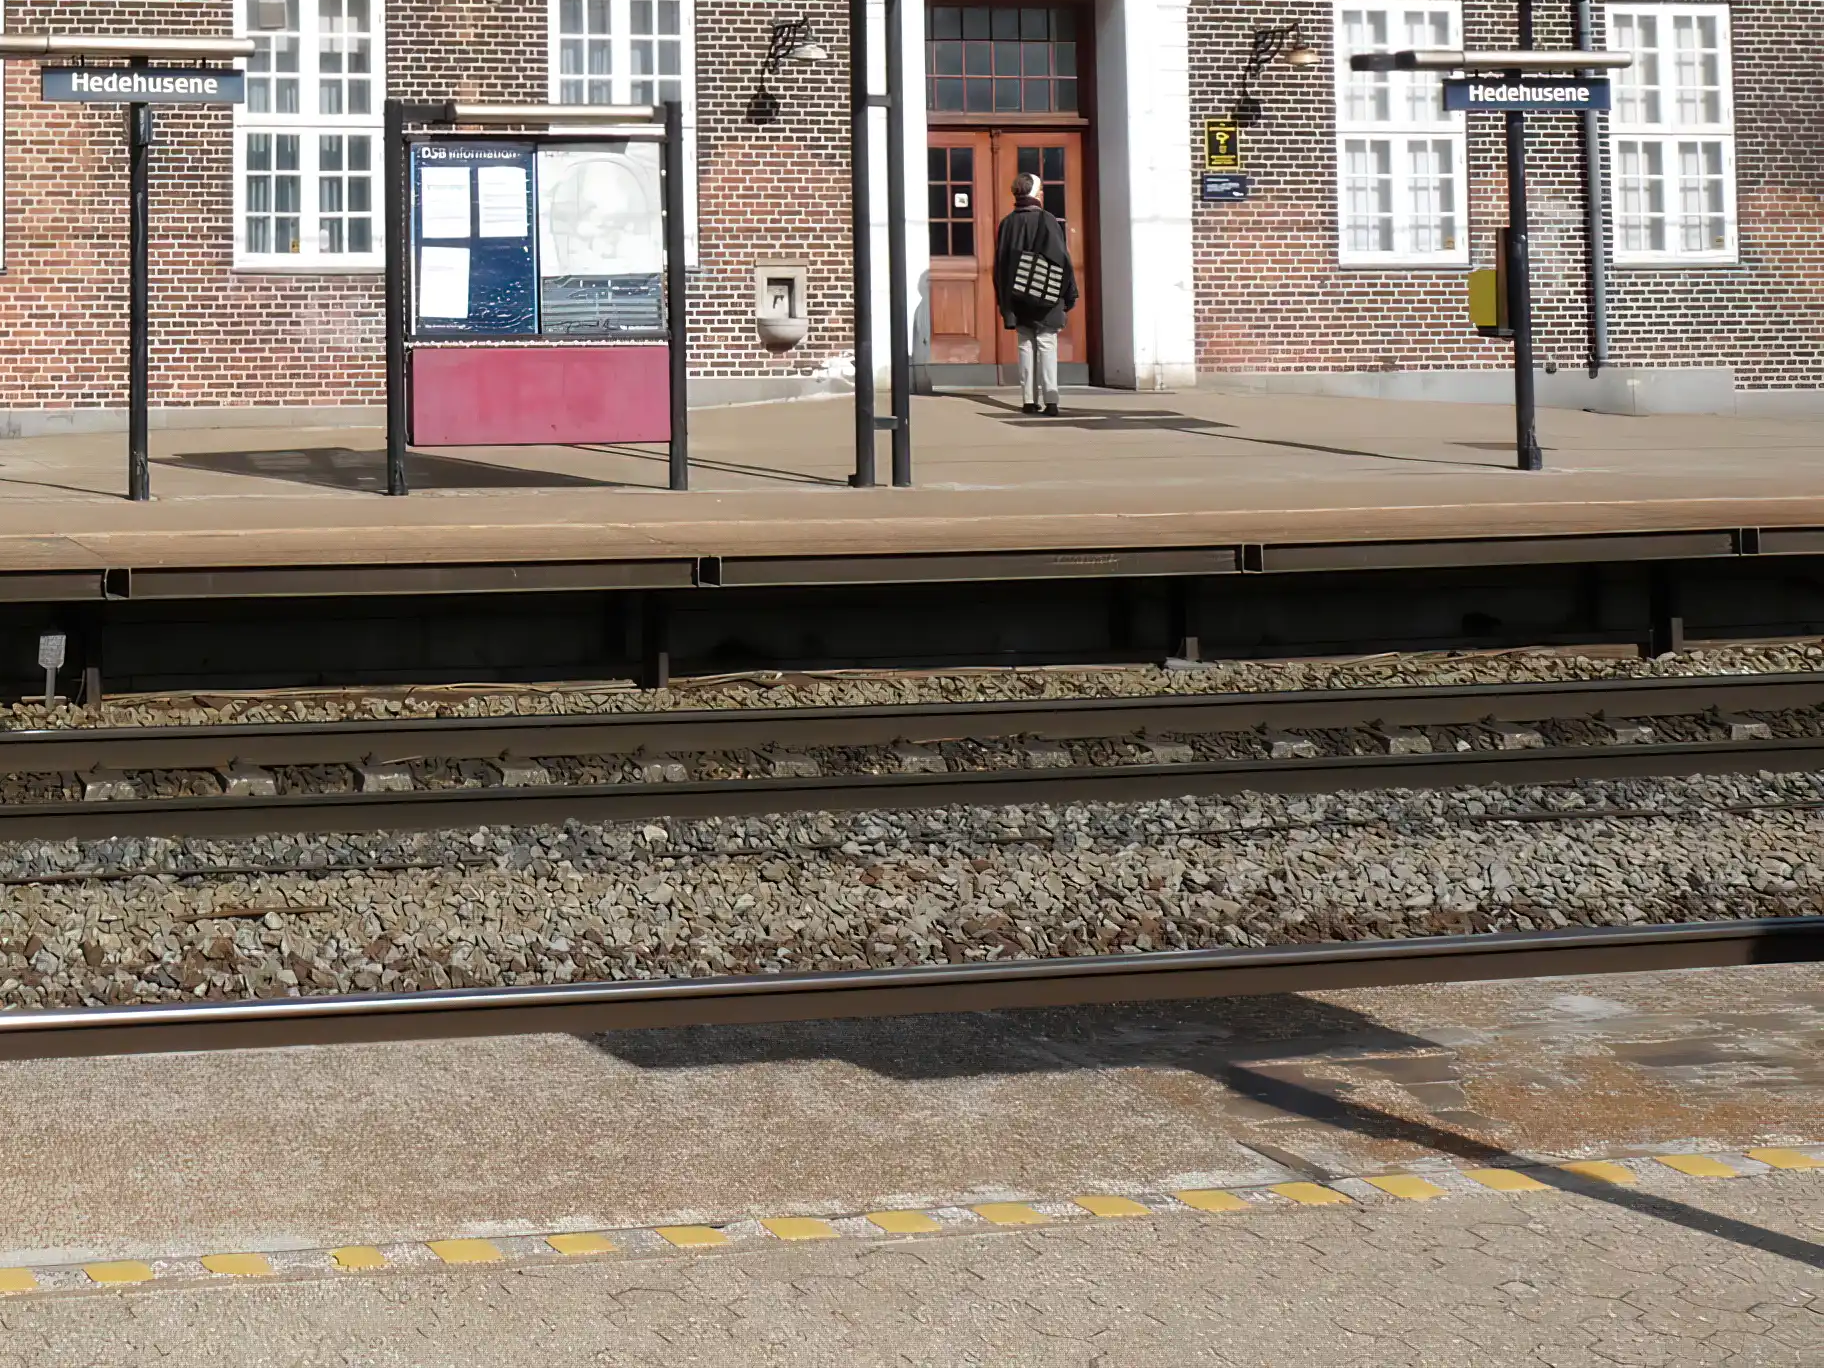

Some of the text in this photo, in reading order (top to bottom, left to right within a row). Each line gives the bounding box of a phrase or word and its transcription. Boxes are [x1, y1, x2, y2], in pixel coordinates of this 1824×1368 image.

[71, 72, 218, 94] Hedehusene
[1469, 84, 1590, 102] Hedehusene
[421, 146, 447, 159] DSB
